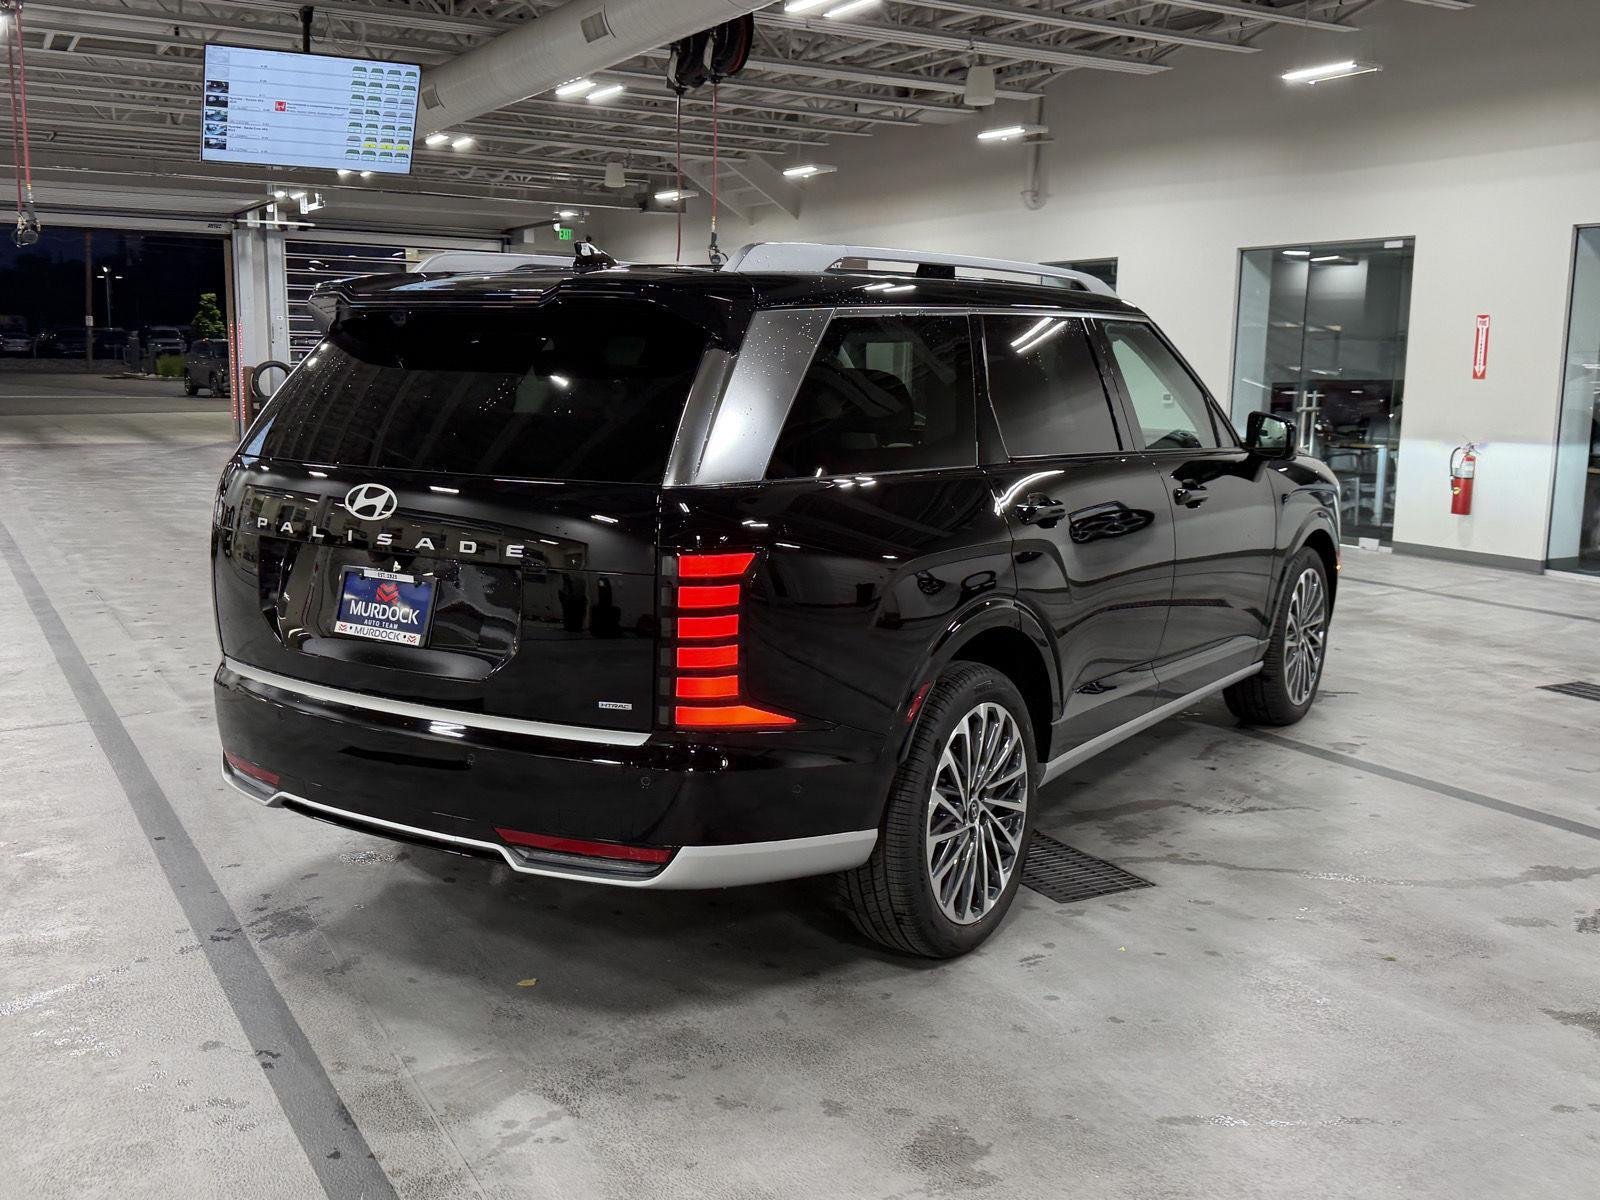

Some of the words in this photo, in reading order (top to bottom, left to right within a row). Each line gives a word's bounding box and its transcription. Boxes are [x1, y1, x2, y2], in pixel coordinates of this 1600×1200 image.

[257, 517, 525, 558] PALISADE
[349, 600, 420, 625] MURDOCK
[354, 626, 400, 641] MURDOCK
[382, 621, 398, 629] TEAM
